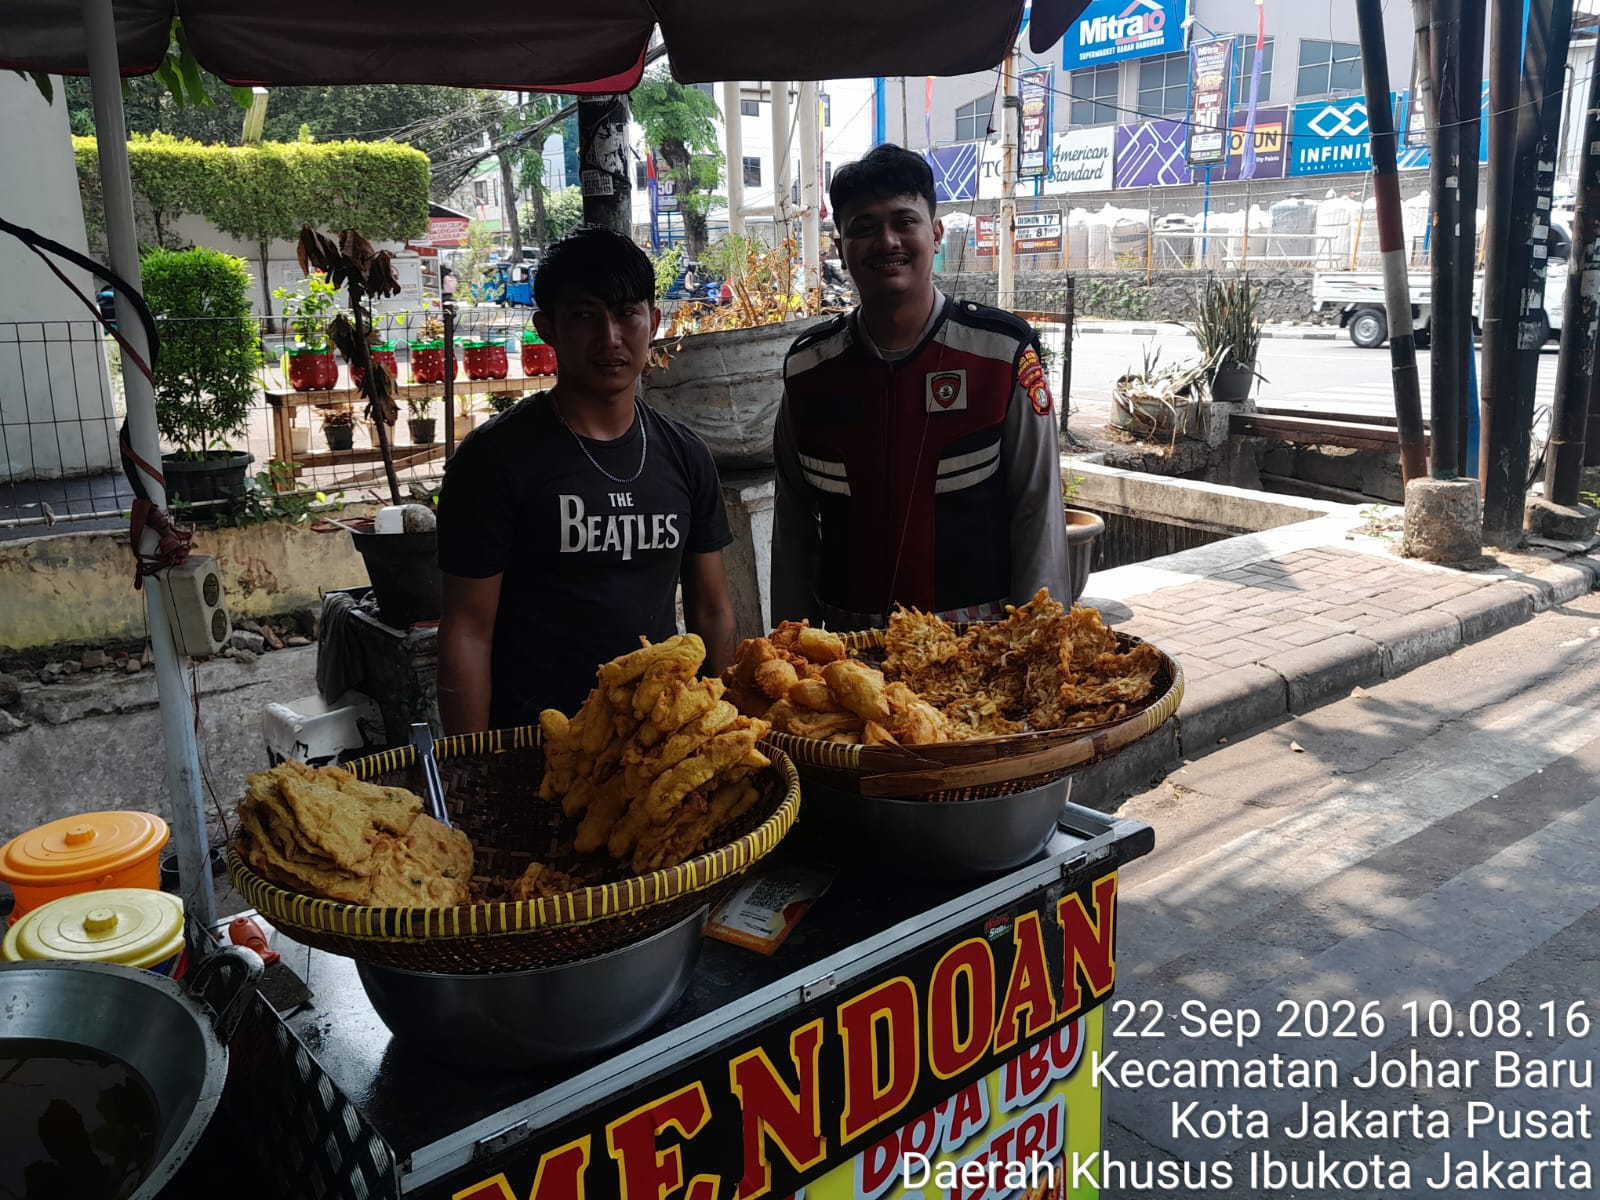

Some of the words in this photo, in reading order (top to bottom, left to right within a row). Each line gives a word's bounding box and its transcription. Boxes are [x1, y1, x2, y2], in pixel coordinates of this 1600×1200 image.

[1079, 9, 1166, 46] Mitra10
[1231, 131, 1277, 150] OUN
[1052, 144, 1109, 163] American
[1300, 143, 1370, 164] INFINIT
[1049, 161, 1105, 183] Standard
[608, 492, 634, 507] THE
[559, 494, 680, 560] BEATLES
